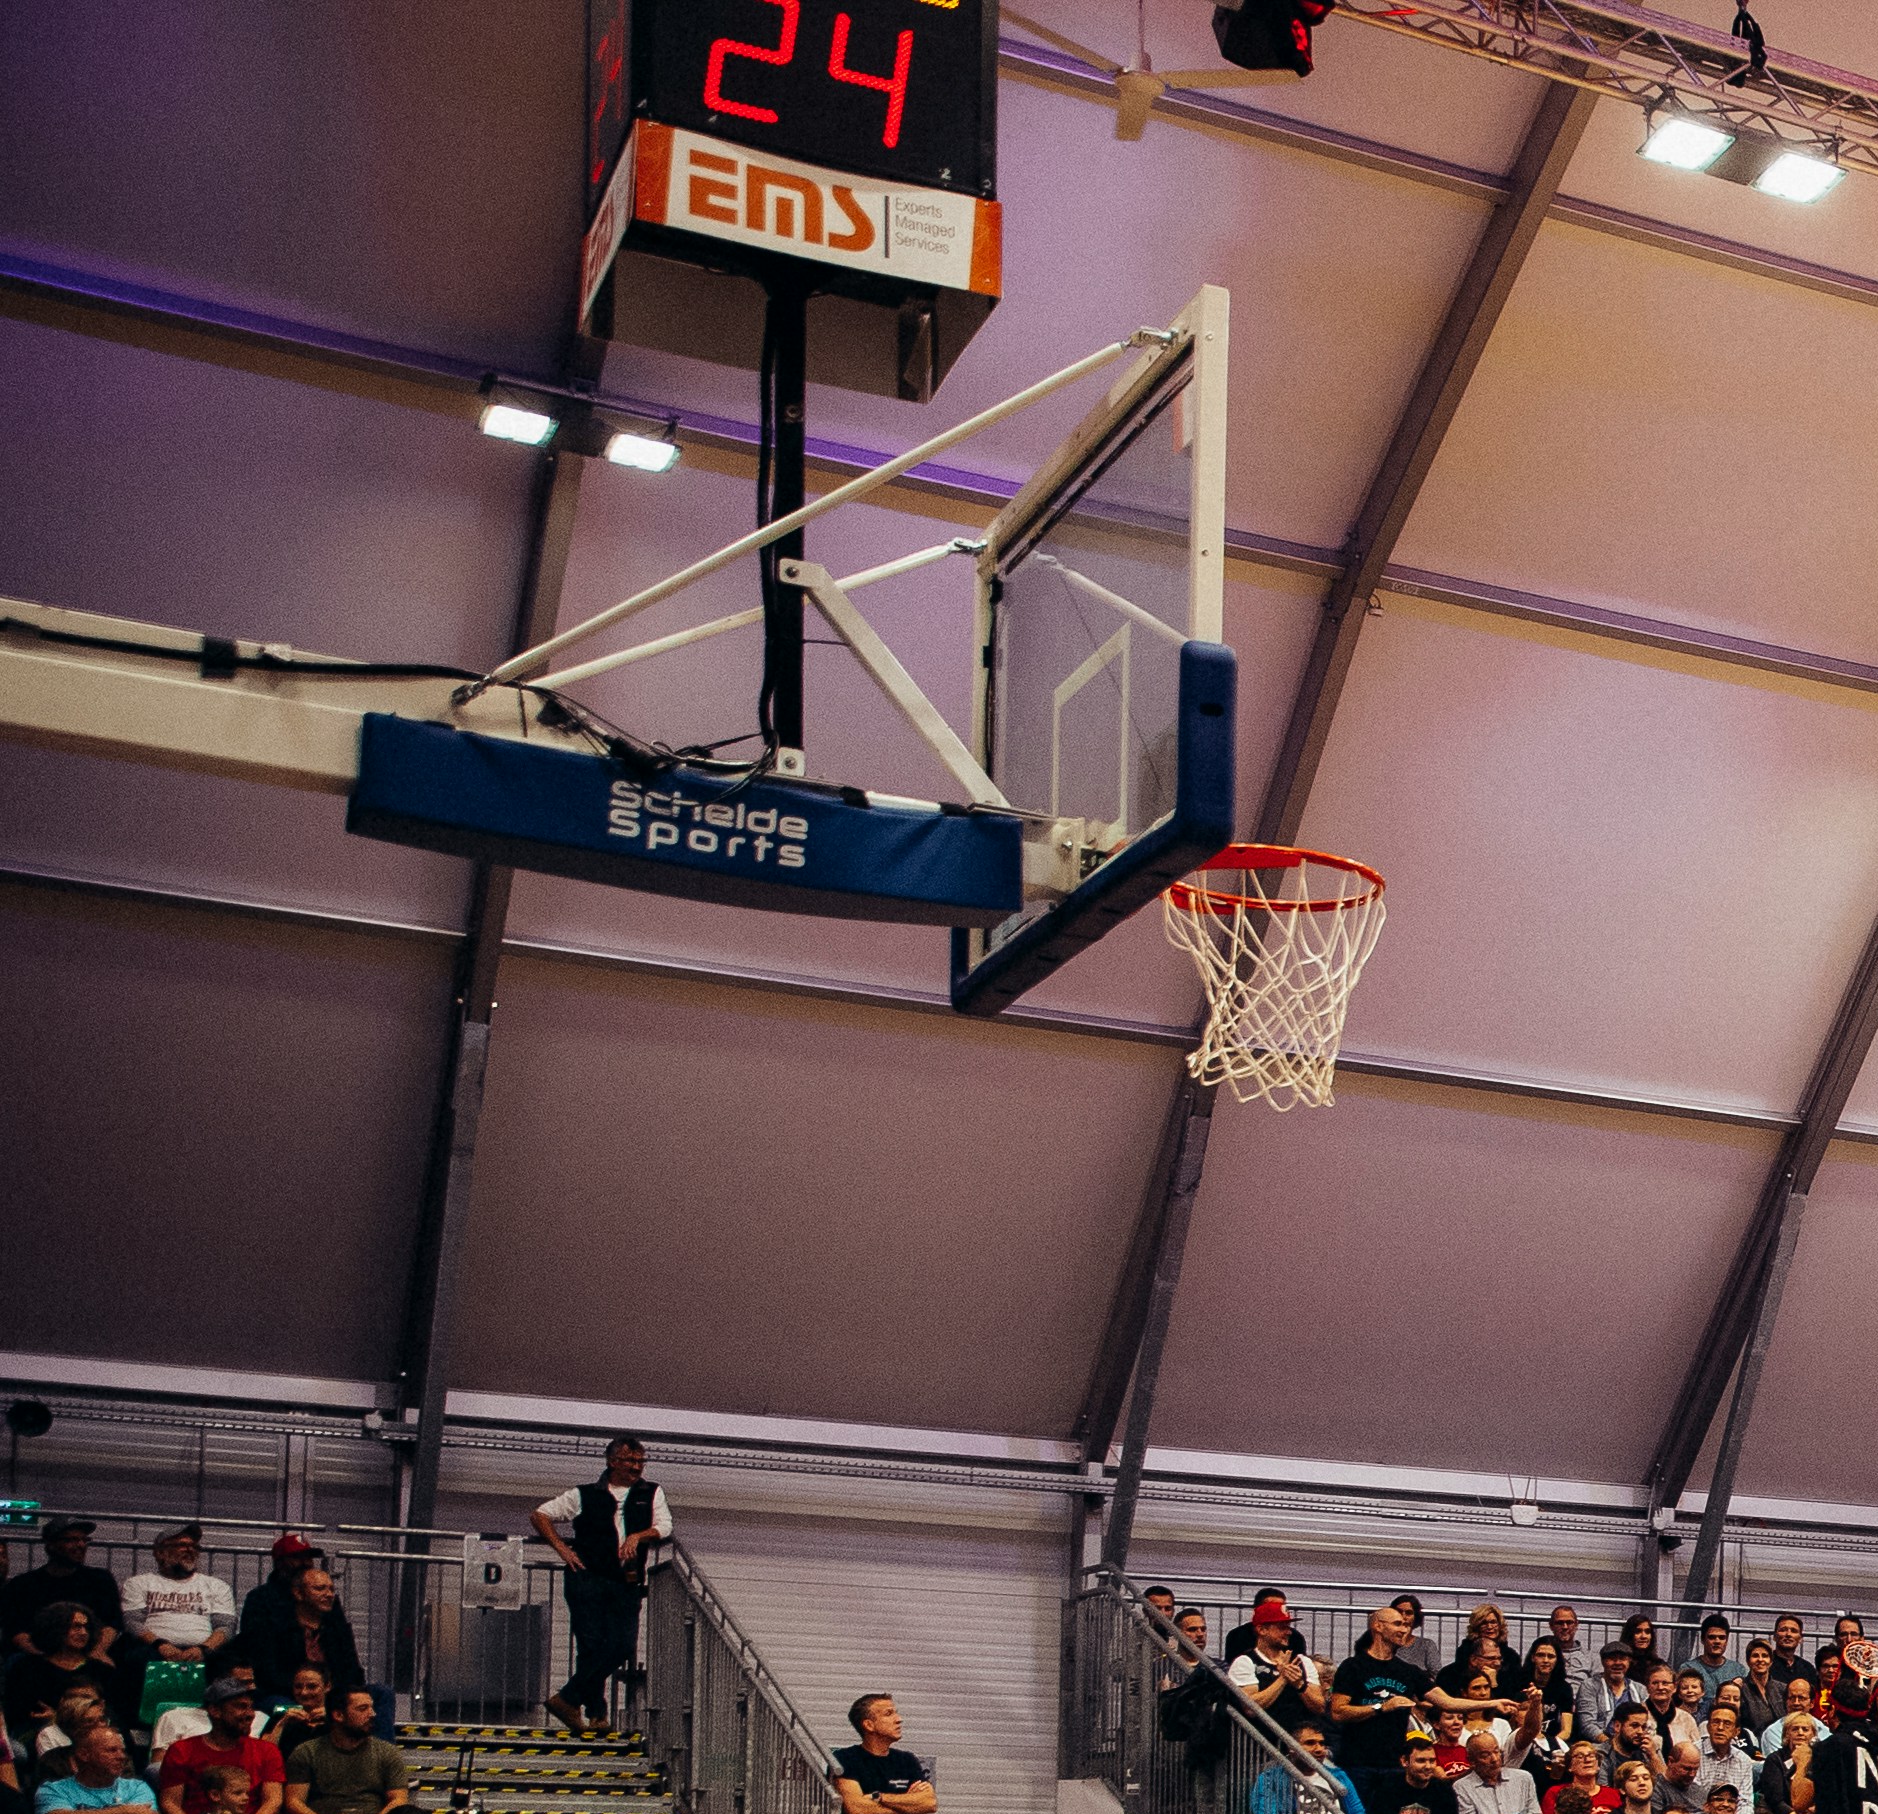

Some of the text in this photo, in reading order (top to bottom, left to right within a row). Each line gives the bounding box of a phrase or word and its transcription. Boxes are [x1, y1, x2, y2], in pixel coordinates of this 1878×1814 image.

[704, 0, 914, 148] 24
[688, 149, 876, 252] EMS
[894, 196, 943, 219] Experts
[893, 231, 950, 255] Services
[894, 214, 956, 239] Managed
[608, 780, 809, 840] Schelde
[607, 807, 806, 868] Sports
[484, 1562, 502, 1584] D
